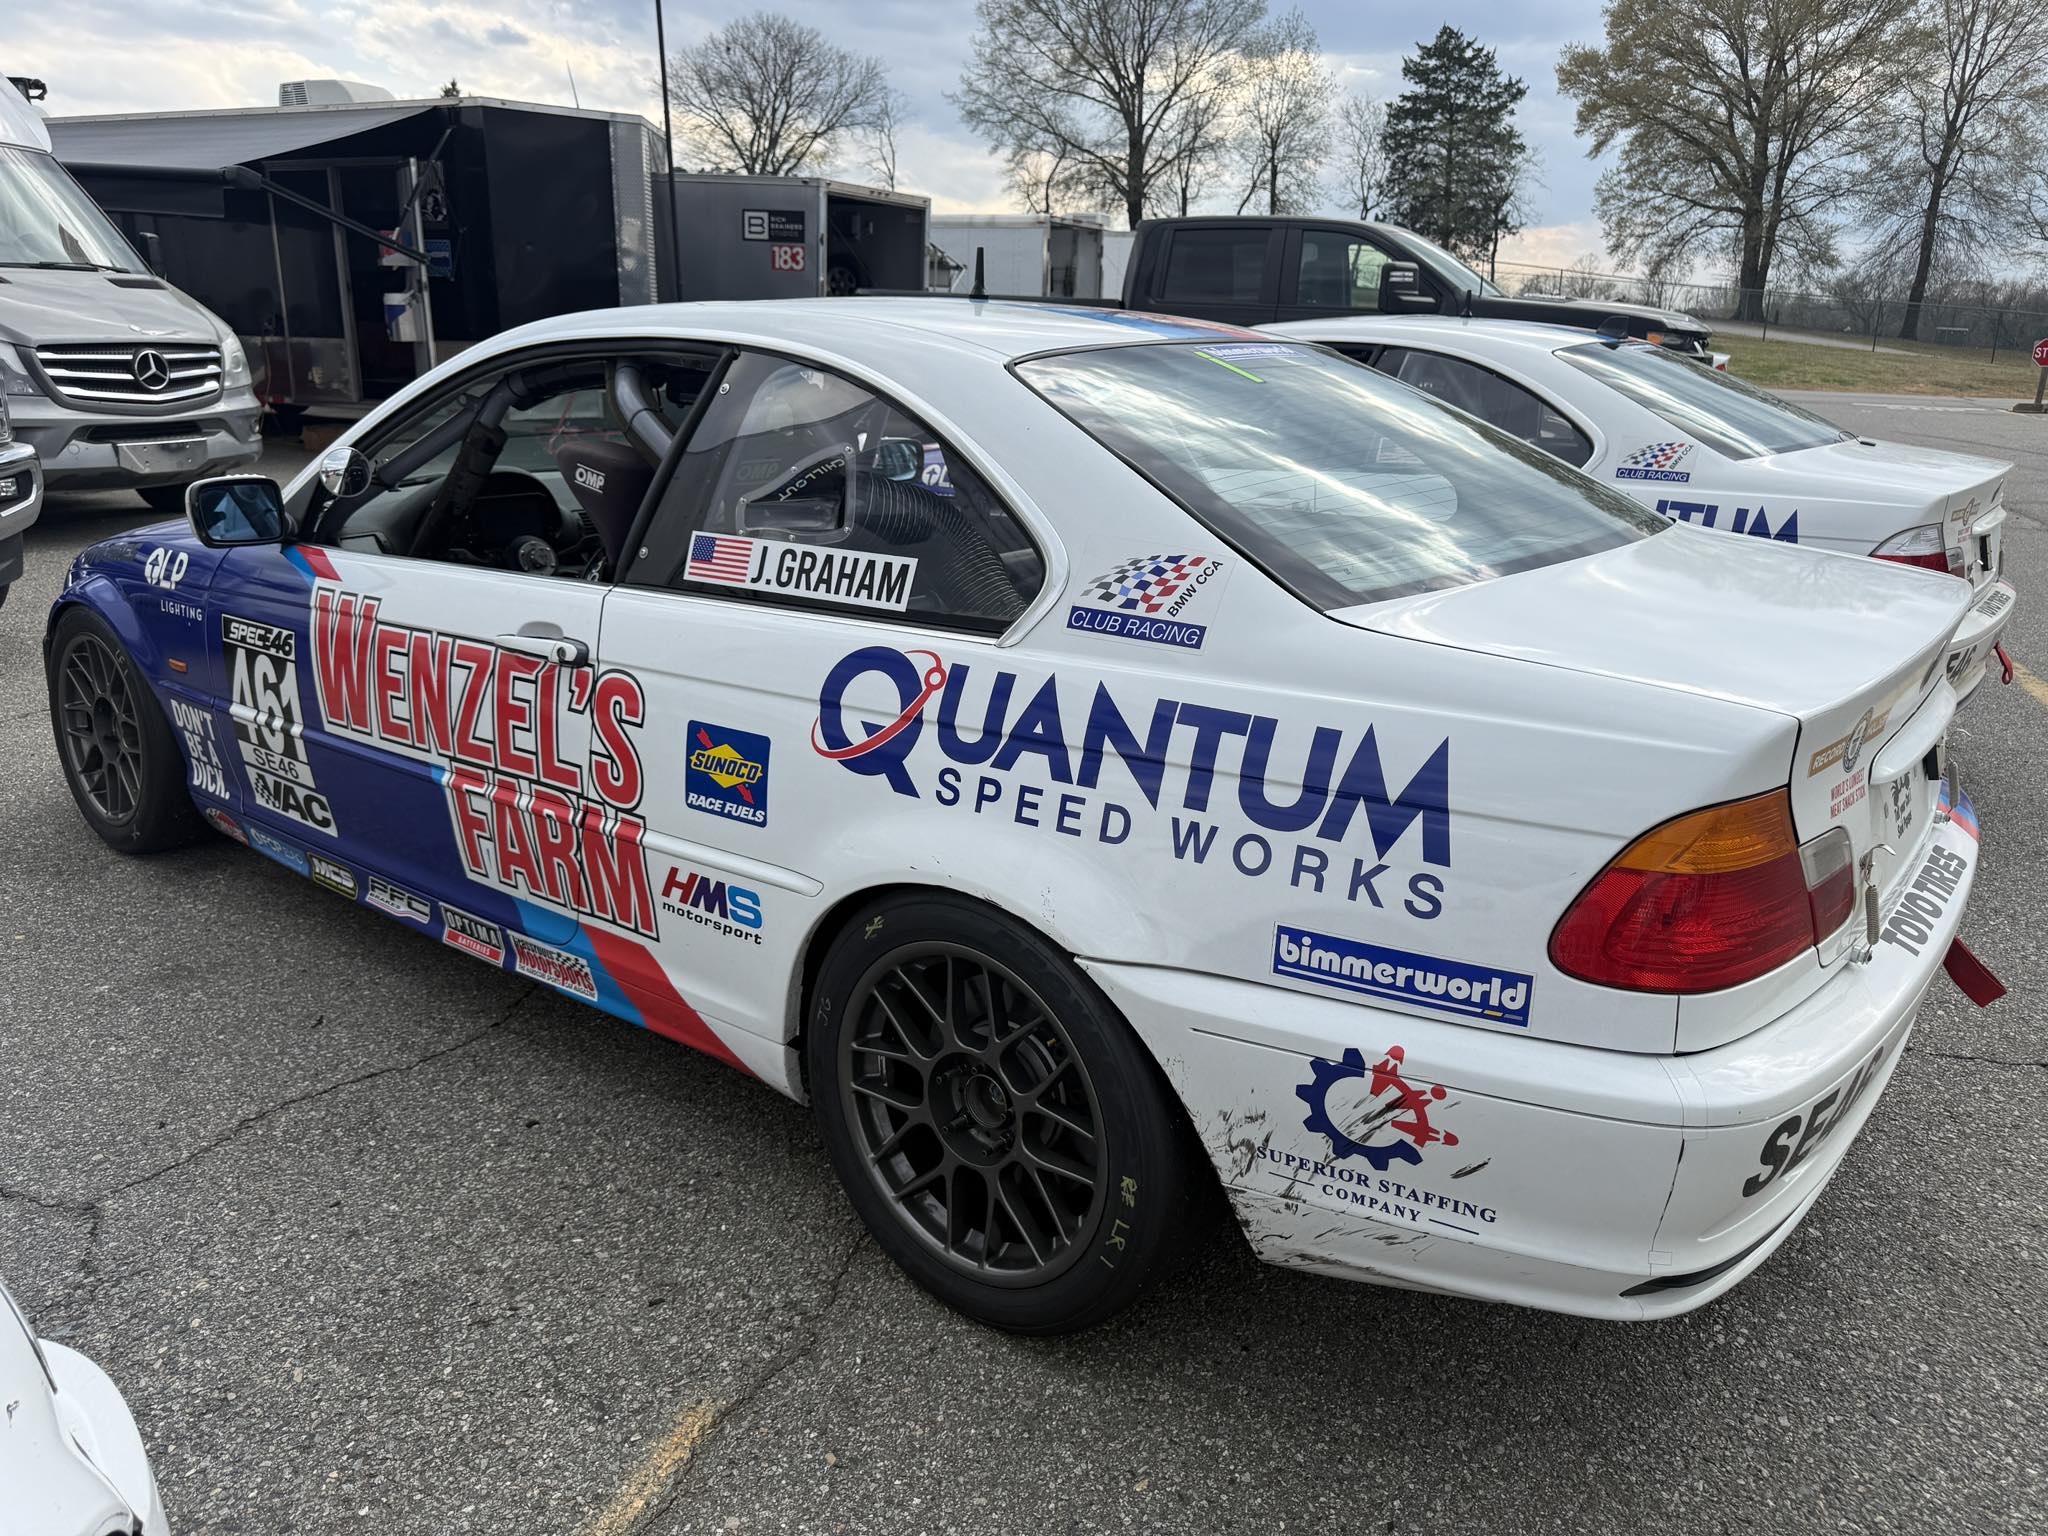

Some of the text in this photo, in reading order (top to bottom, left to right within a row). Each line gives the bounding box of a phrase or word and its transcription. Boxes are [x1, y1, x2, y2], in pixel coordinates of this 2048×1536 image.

[772, 246, 804, 270] 183
[2034, 346, 2048, 358] ST
[575, 467, 605, 489] OMP
[737, 463, 779, 481] OMP
[1618, 469, 1688, 481] CLUB RACING
[1668, 456, 1684, 471] BMW
[750, 546, 910, 604] J.GRAHAM
[1167, 560, 1224, 618] BMW CCA
[160, 599, 203, 622] LIGHTING
[1071, 610, 1201, 646] CLUB RACING
[229, 647, 309, 763] 461
[312, 588, 646, 811] WENZEL'S
[170, 698, 215, 741] DON'T
[184, 730, 223, 770] BE A
[253, 747, 299, 779] SE46
[693, 751, 761, 782] SUNOCO
[812, 645, 1451, 868] QUANTUM
[191, 757, 230, 800] DICK.
[256, 772, 332, 829] VAC
[687, 792, 766, 823] RACE FUELS
[448, 761, 660, 942] FARM
[935, 767, 1445, 919] SPEED WORKS
[312, 857, 355, 888] MCS
[370, 892, 401, 910] BRAKES
[371, 878, 429, 917] PFC
[662, 866, 762, 929] HMS
[1880, 845, 1967, 957] TOYO TIRES
[446, 911, 504, 948] OPTIMA
[662, 900, 762, 946] motorsport
[458, 935, 490, 957] BATTERIES
[1278, 933, 1527, 1011] bimmerworld
[1255, 1145, 1499, 1224] SUPERIOR STAFFING
[1321, 1182, 1422, 1223] COMPANY
[1105, 1218, 1130, 1252] LR
